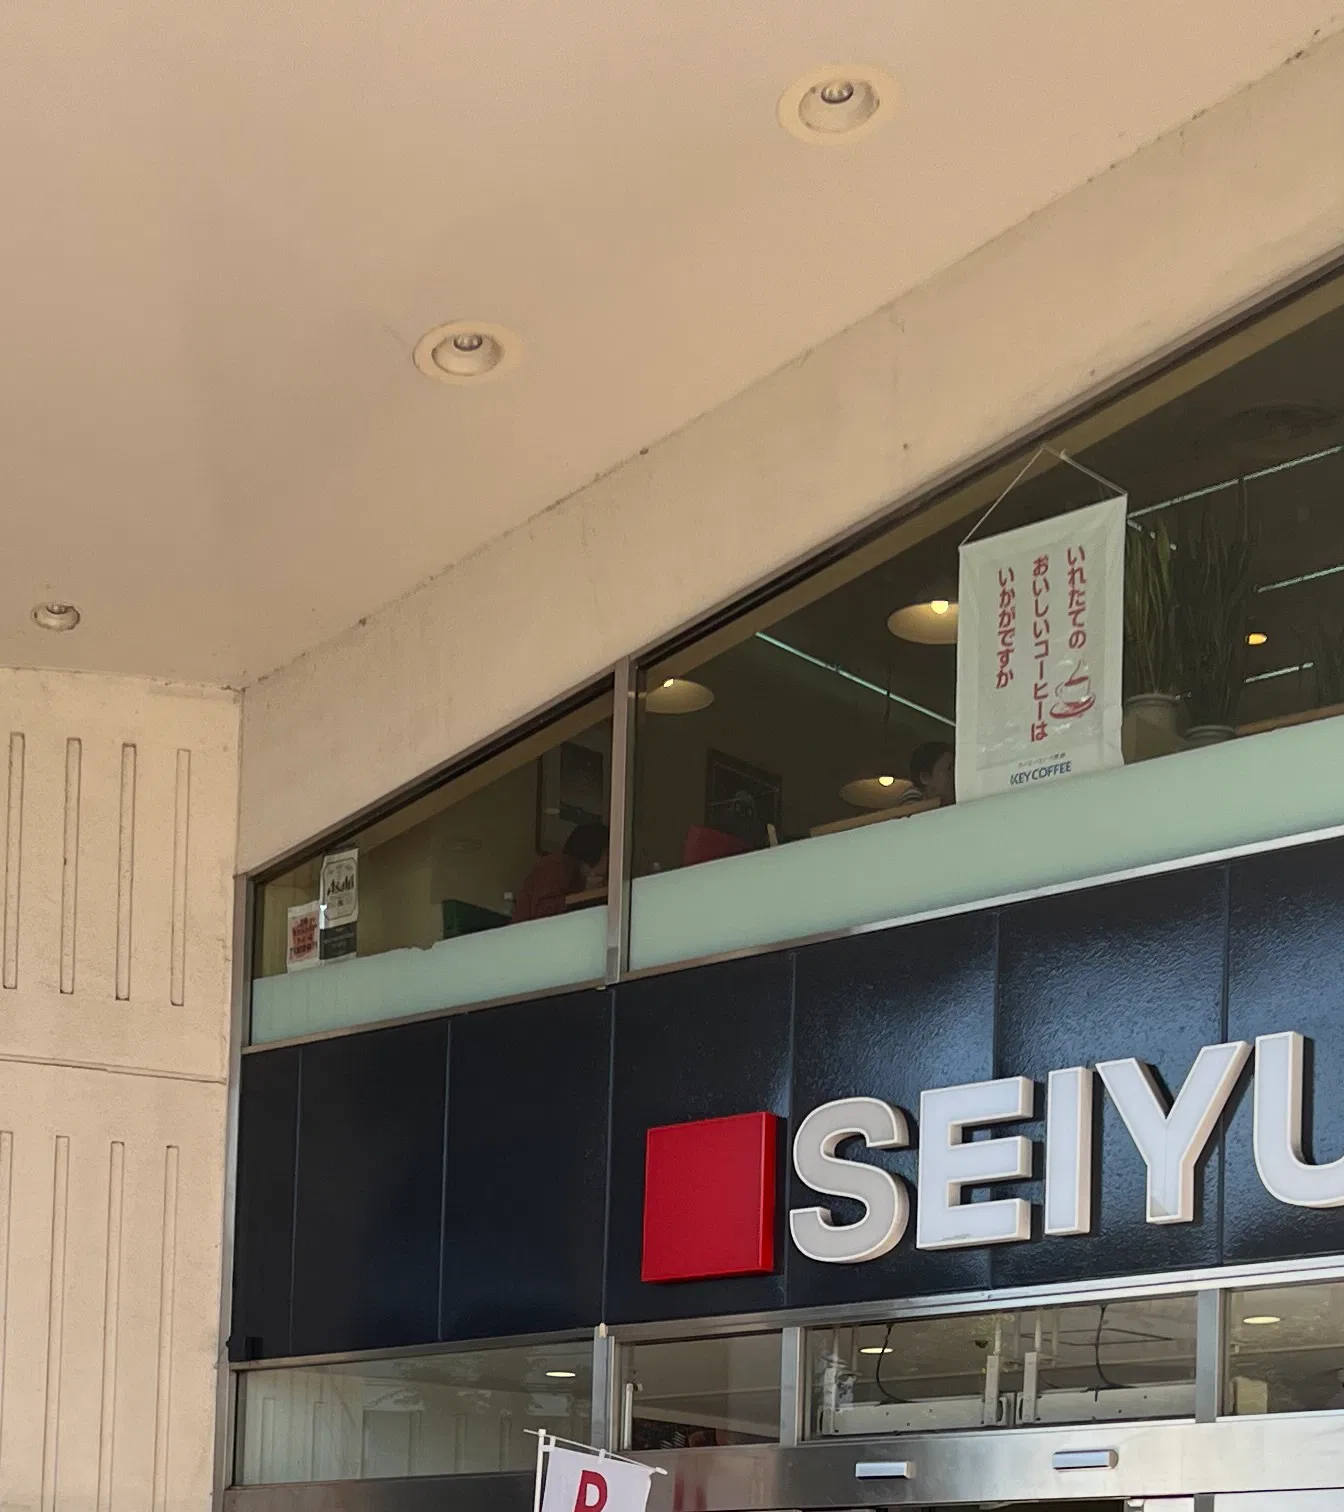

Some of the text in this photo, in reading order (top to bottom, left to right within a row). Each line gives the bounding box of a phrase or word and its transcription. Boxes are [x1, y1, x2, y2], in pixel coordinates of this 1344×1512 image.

[996, 567, 1016, 690] いかがですか
[1031, 555, 1050, 743] おいしいコーヒーは
[1067, 545, 1087, 650] いれたての
